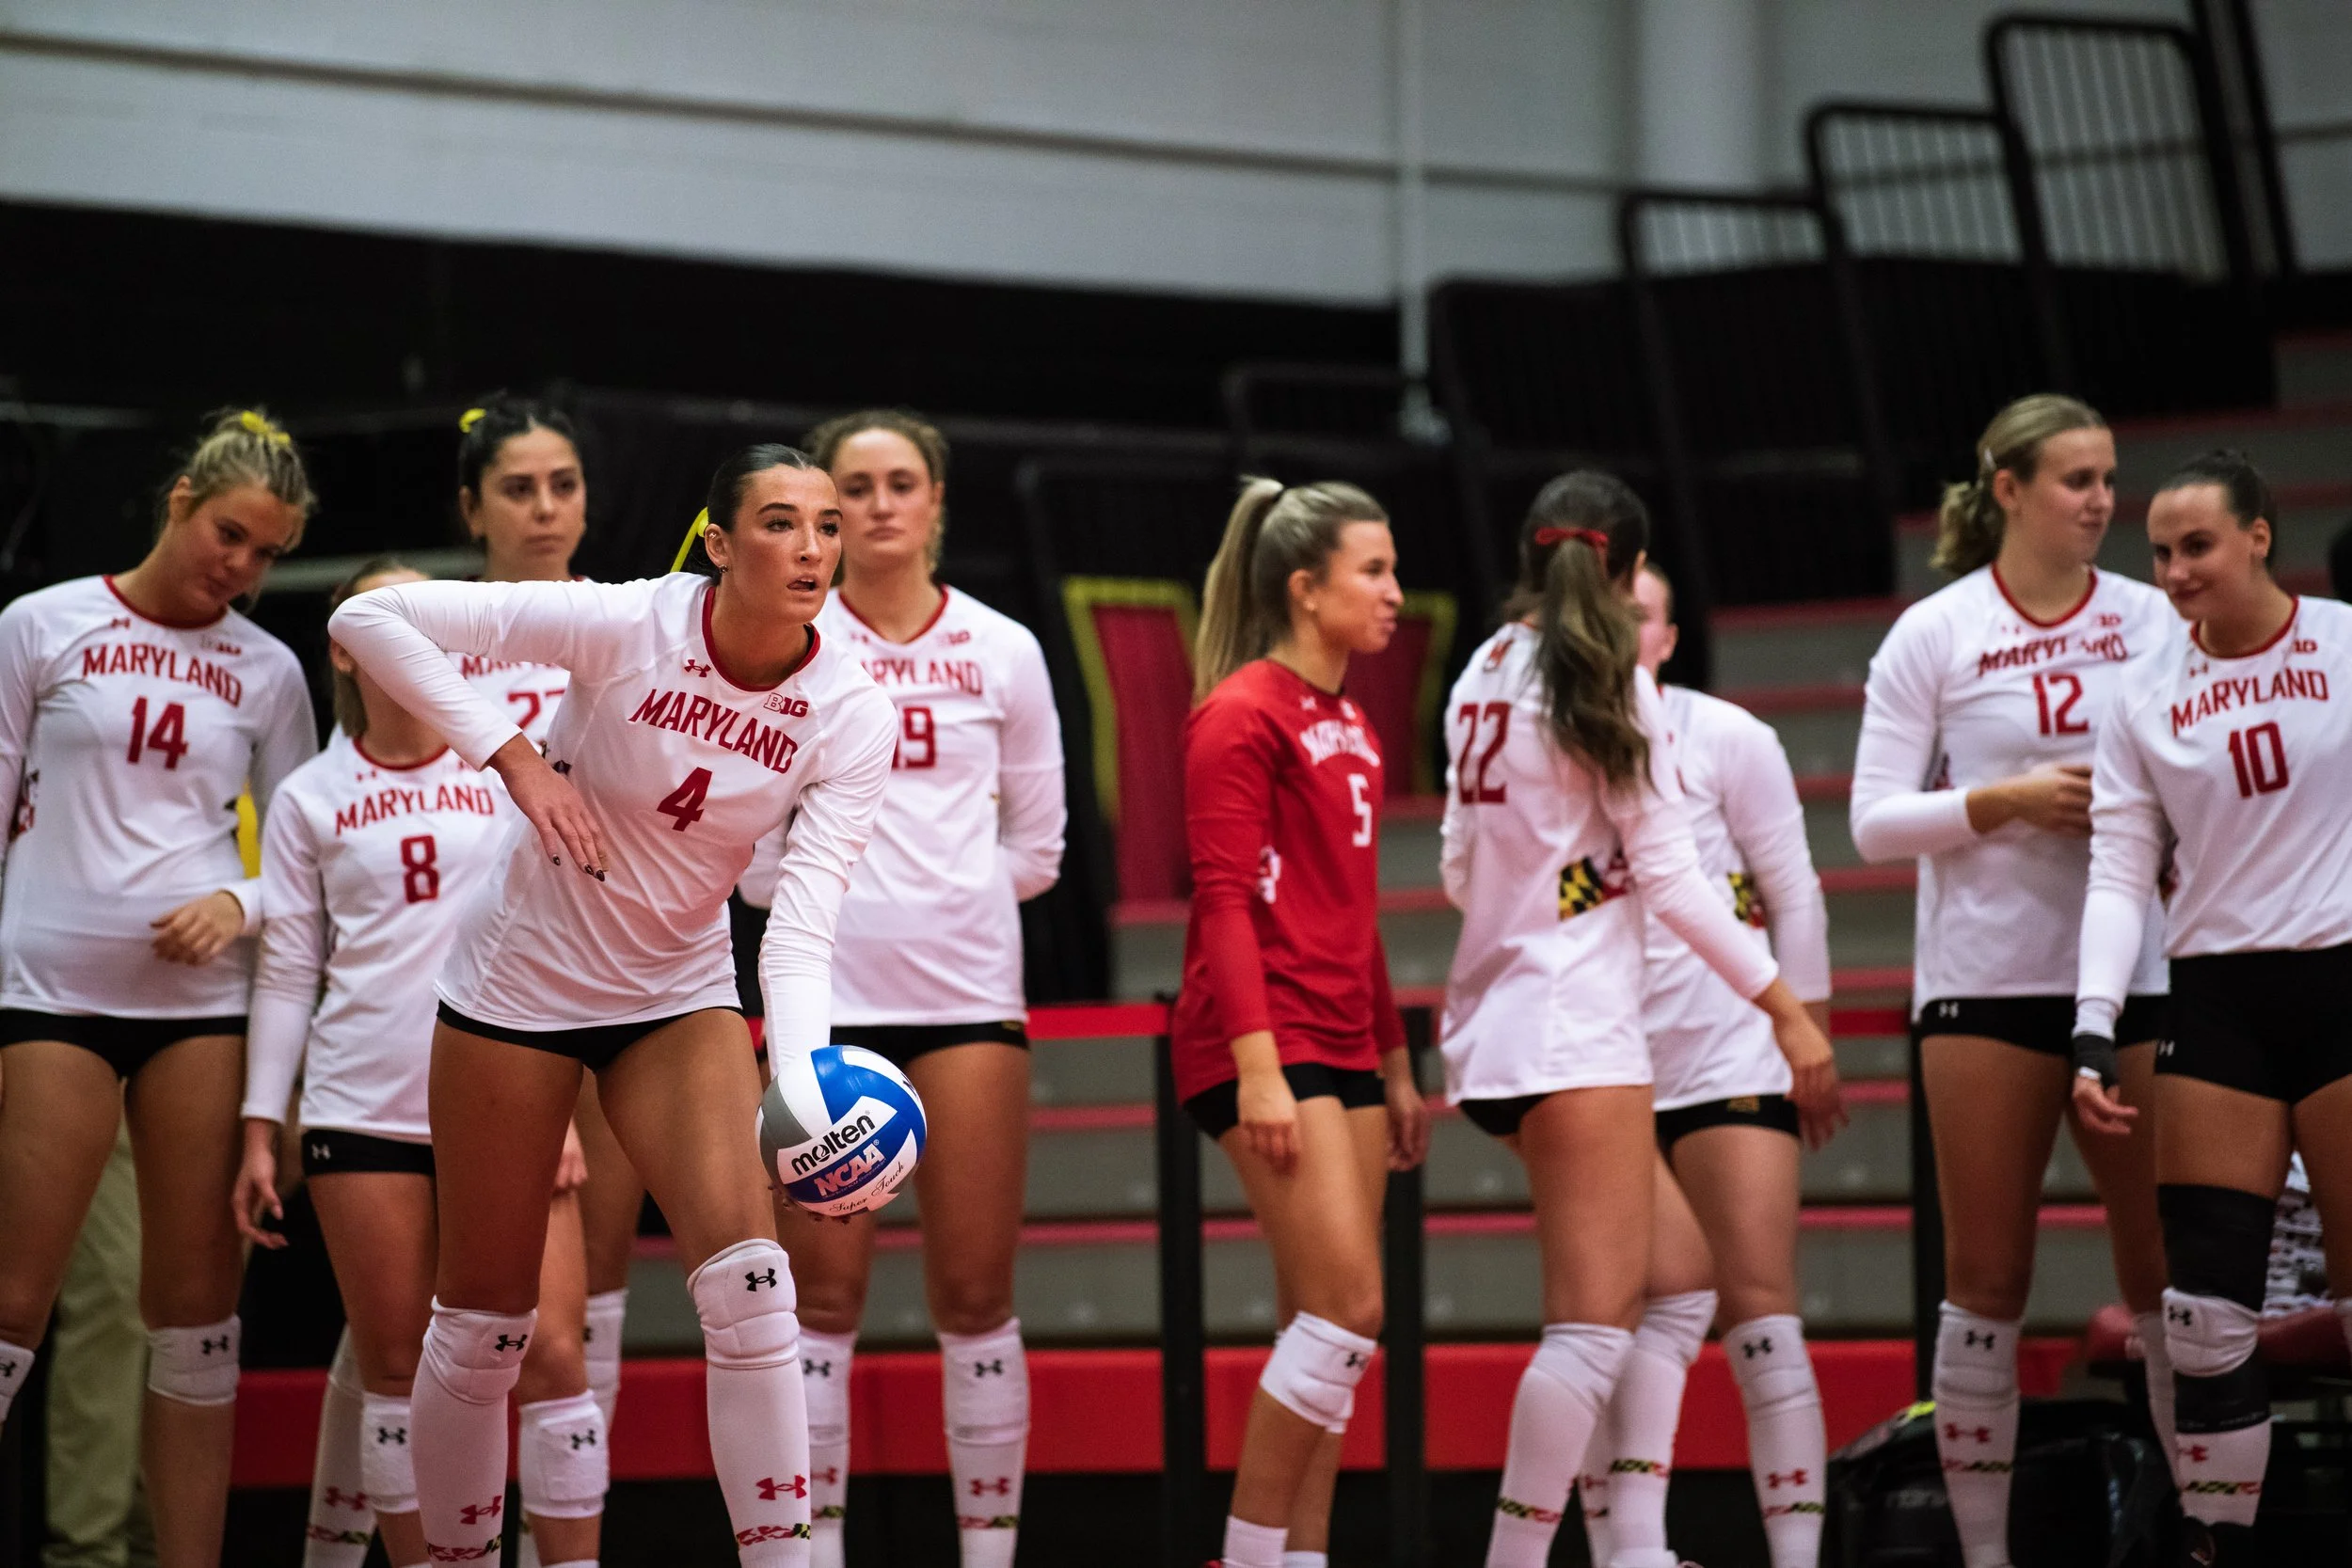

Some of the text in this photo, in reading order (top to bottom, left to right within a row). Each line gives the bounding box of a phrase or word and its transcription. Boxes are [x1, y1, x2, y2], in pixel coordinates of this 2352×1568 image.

[83, 642, 243, 707] MARYLAND
[860, 657, 984, 697] RYLAND
[2032, 673, 2089, 736] 12
[2169, 667, 2329, 739] MARYLAND
[126, 695, 190, 770] 14
[507, 688, 565, 730] 2
[628, 688, 799, 774] MARYLAND
[1458, 701, 1511, 805] 22
[2228, 721, 2290, 799] 10
[335, 784, 495, 837] MARYLAND
[656, 767, 712, 832] 4
[1347, 773, 1373, 847] 5
[400, 834, 440, 904] 8
[791, 1113, 876, 1176] molten
[814, 1143, 885, 1196] NCAA
[829, 1197, 867, 1212] Super
[870, 1161, 904, 1197] Touch
